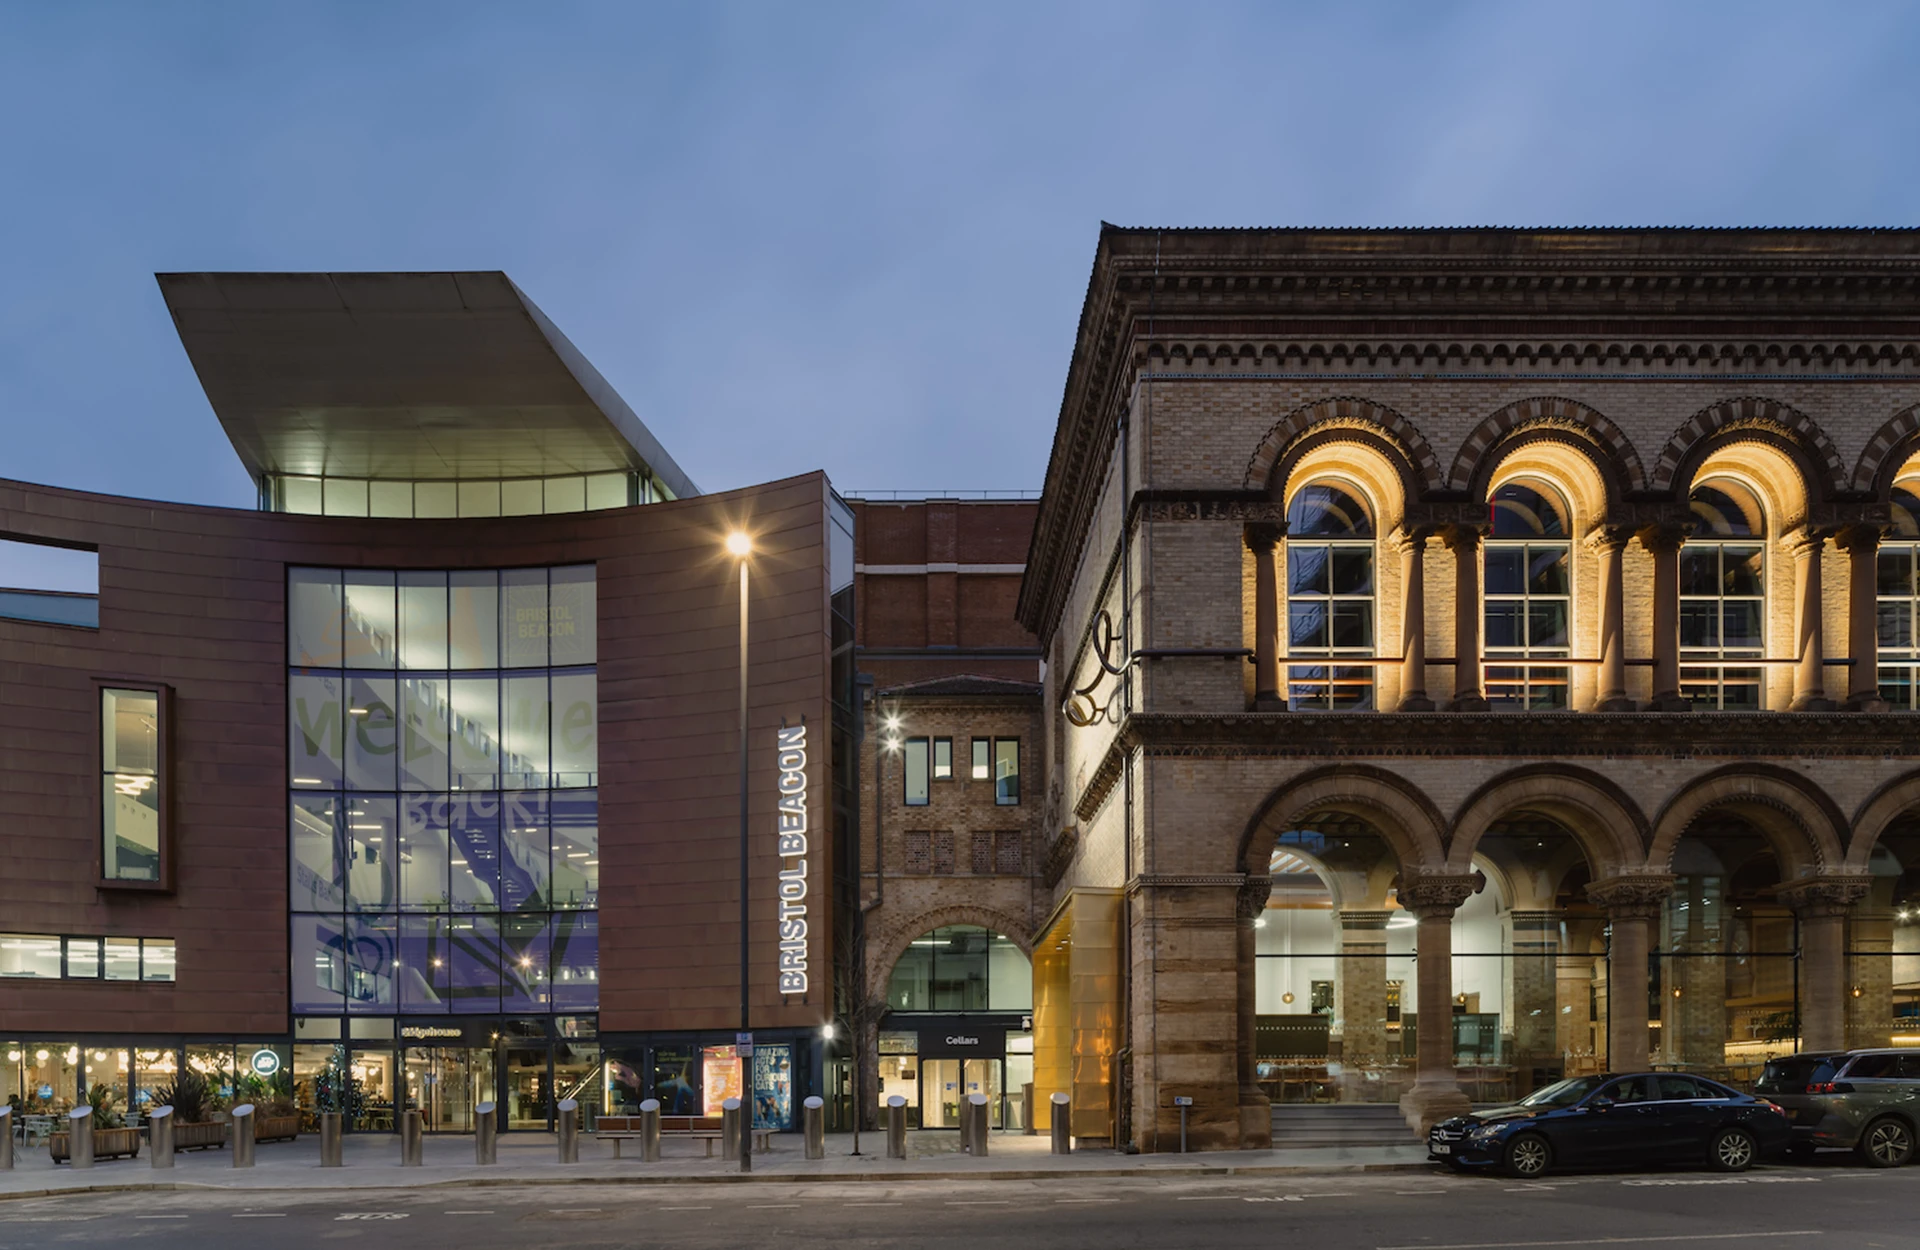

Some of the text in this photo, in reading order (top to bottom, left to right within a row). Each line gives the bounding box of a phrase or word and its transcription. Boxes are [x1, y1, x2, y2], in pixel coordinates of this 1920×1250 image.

[516, 607, 573, 622] BRISTOL
[518, 622, 574, 637] BEACON
[778, 726, 808, 994] BRISTOL BEACON
[946, 1036, 979, 1045] Cellars
[755, 1047, 789, 1057] AMAZING
[755, 1056, 775, 1066] ACTS
[755, 1065, 770, 1074] FOR
[755, 1073, 788, 1082] CURIOUS
[755, 1081, 775, 1090] CATS
